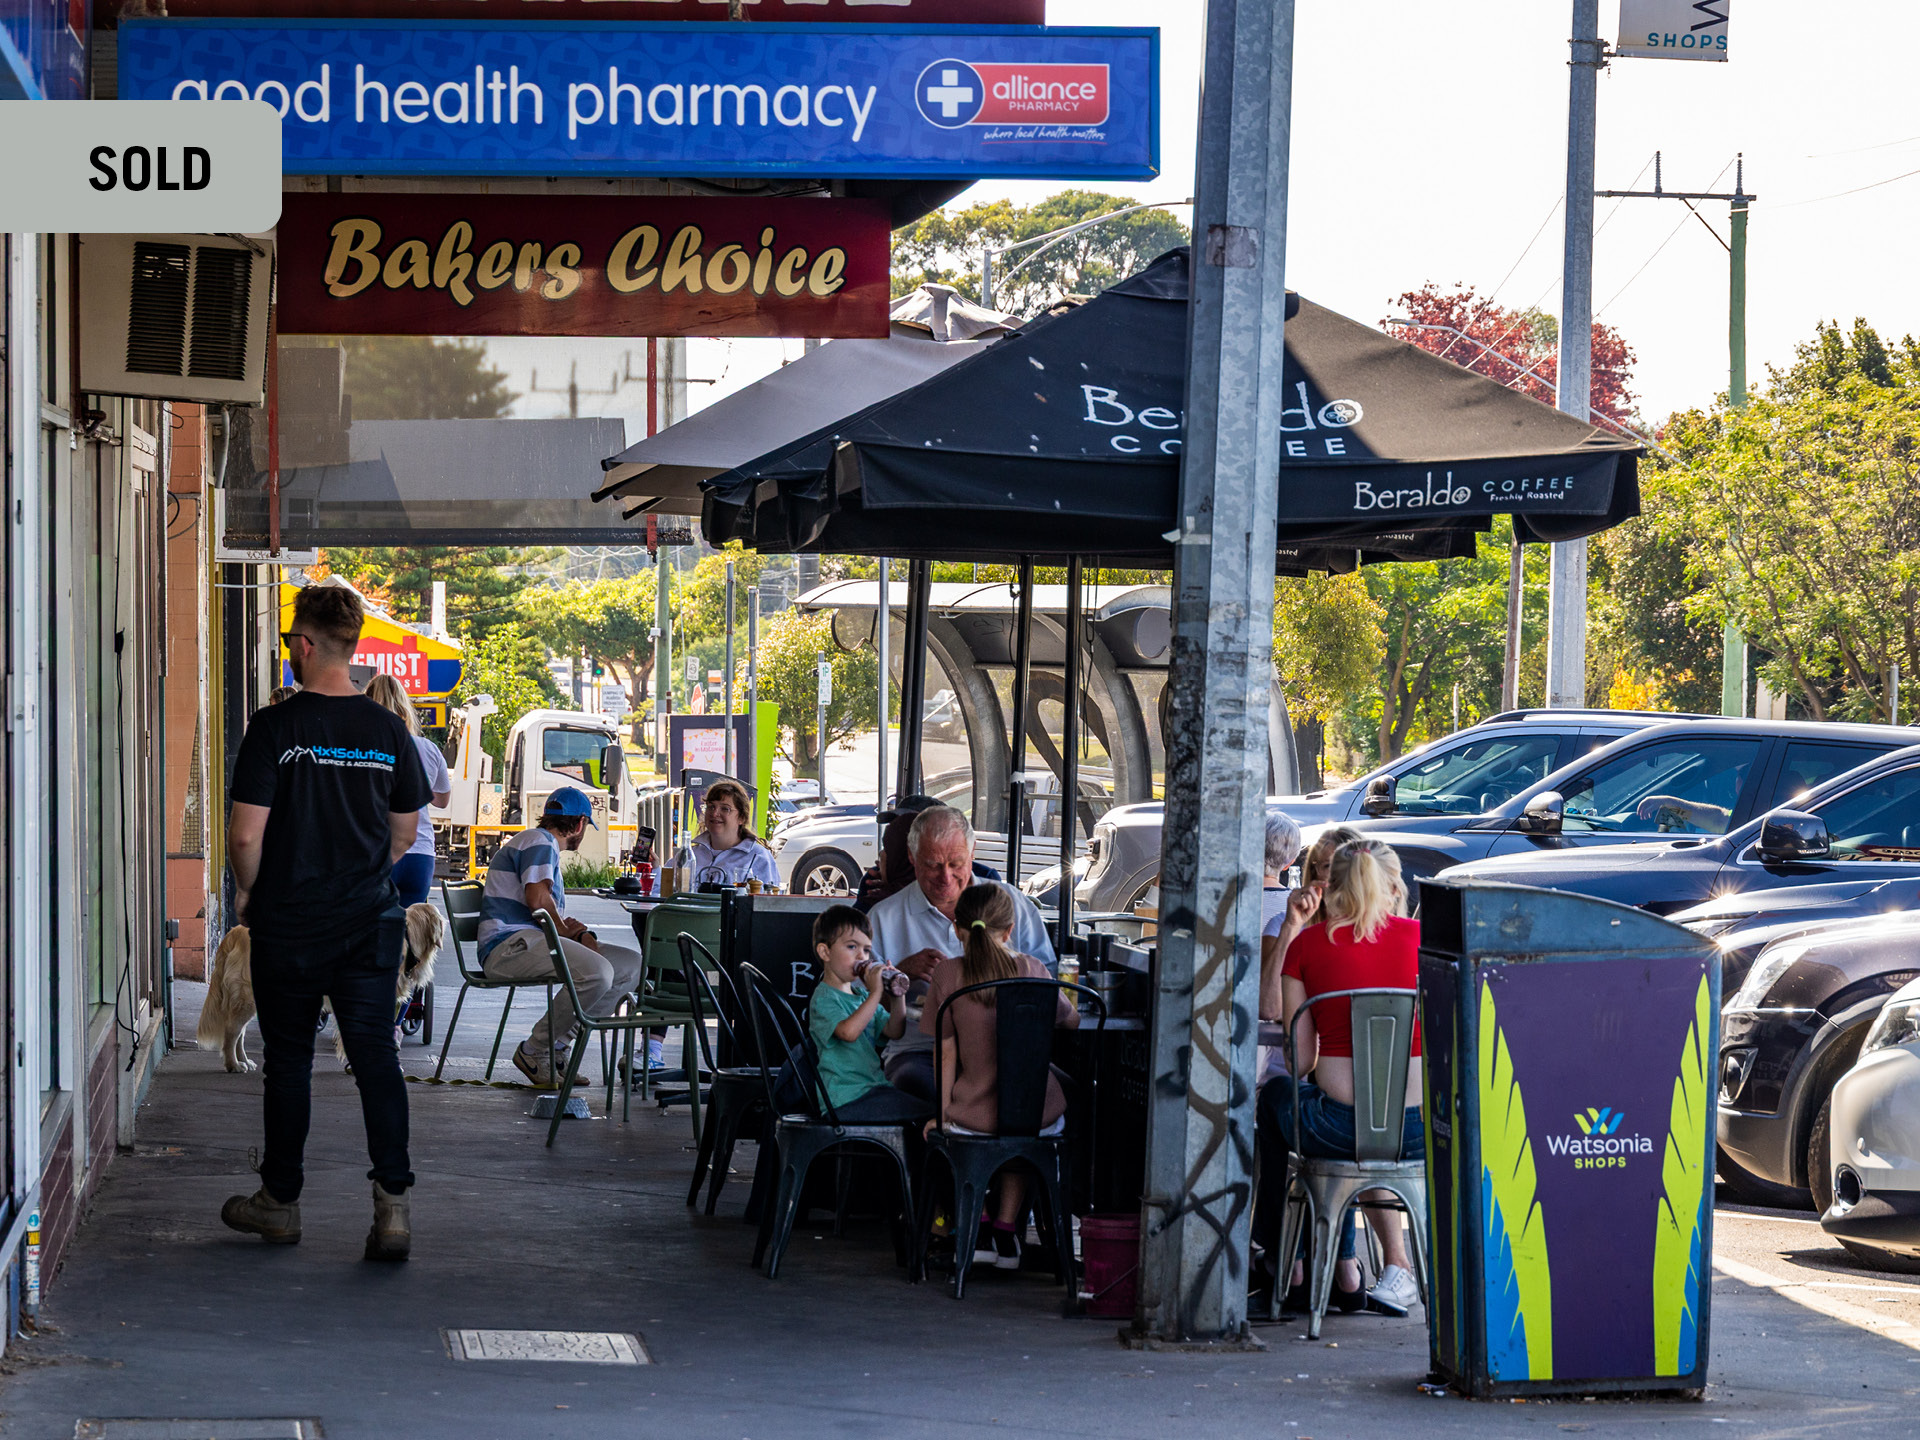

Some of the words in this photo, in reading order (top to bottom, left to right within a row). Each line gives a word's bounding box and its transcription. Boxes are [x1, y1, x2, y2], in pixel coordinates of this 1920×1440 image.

[1647, 32, 1727, 50] SHOPS
[992, 74, 1097, 99] alliance
[355, 63, 543, 124] health
[568, 66, 877, 142] pharmacy
[1009, 101, 1080, 112] PHARMACY
[983, 127, 1013, 140] where
[1015, 126, 1038, 139] local
[1038, 126, 1070, 139] health
[1072, 128, 1106, 140] matters
[323, 218, 583, 307] Bakers
[606, 224, 848, 299] Choice
[1080, 381, 1364, 432] Bedo
[1110, 435, 1347, 457] COEE
[1353, 471, 1472, 511] Beraldo
[1482, 475, 1575, 494] COFFEE
[1490, 493, 1524, 503] Freshly
[1526, 490, 1564, 500] Roasted
[351, 653, 421, 676] EMIST
[1546, 1132, 1654, 1156] Watsonia
[1574, 1156, 1627, 1169] SHOPS
